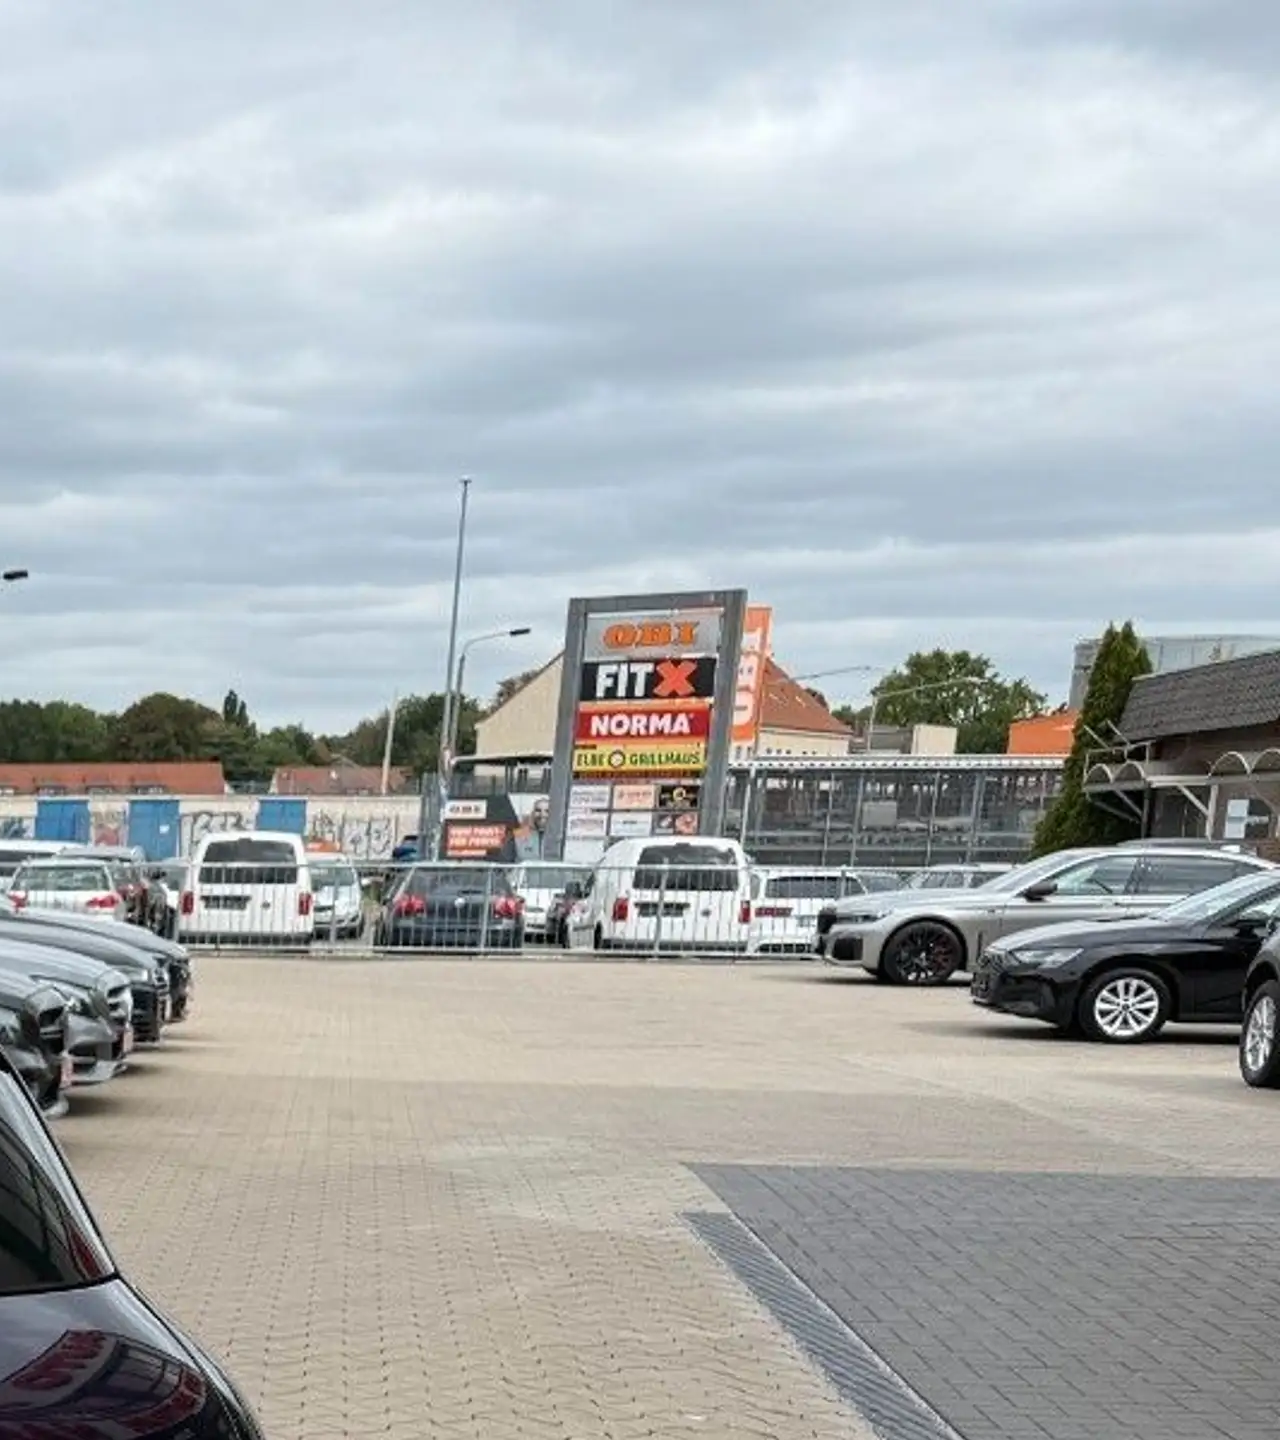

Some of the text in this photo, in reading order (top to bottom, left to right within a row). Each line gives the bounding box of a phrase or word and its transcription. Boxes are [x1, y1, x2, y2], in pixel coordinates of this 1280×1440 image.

[603, 621, 698, 648] OBI
[590, 713, 692, 737] NORMA
[577, 751, 605, 767] ELBE
